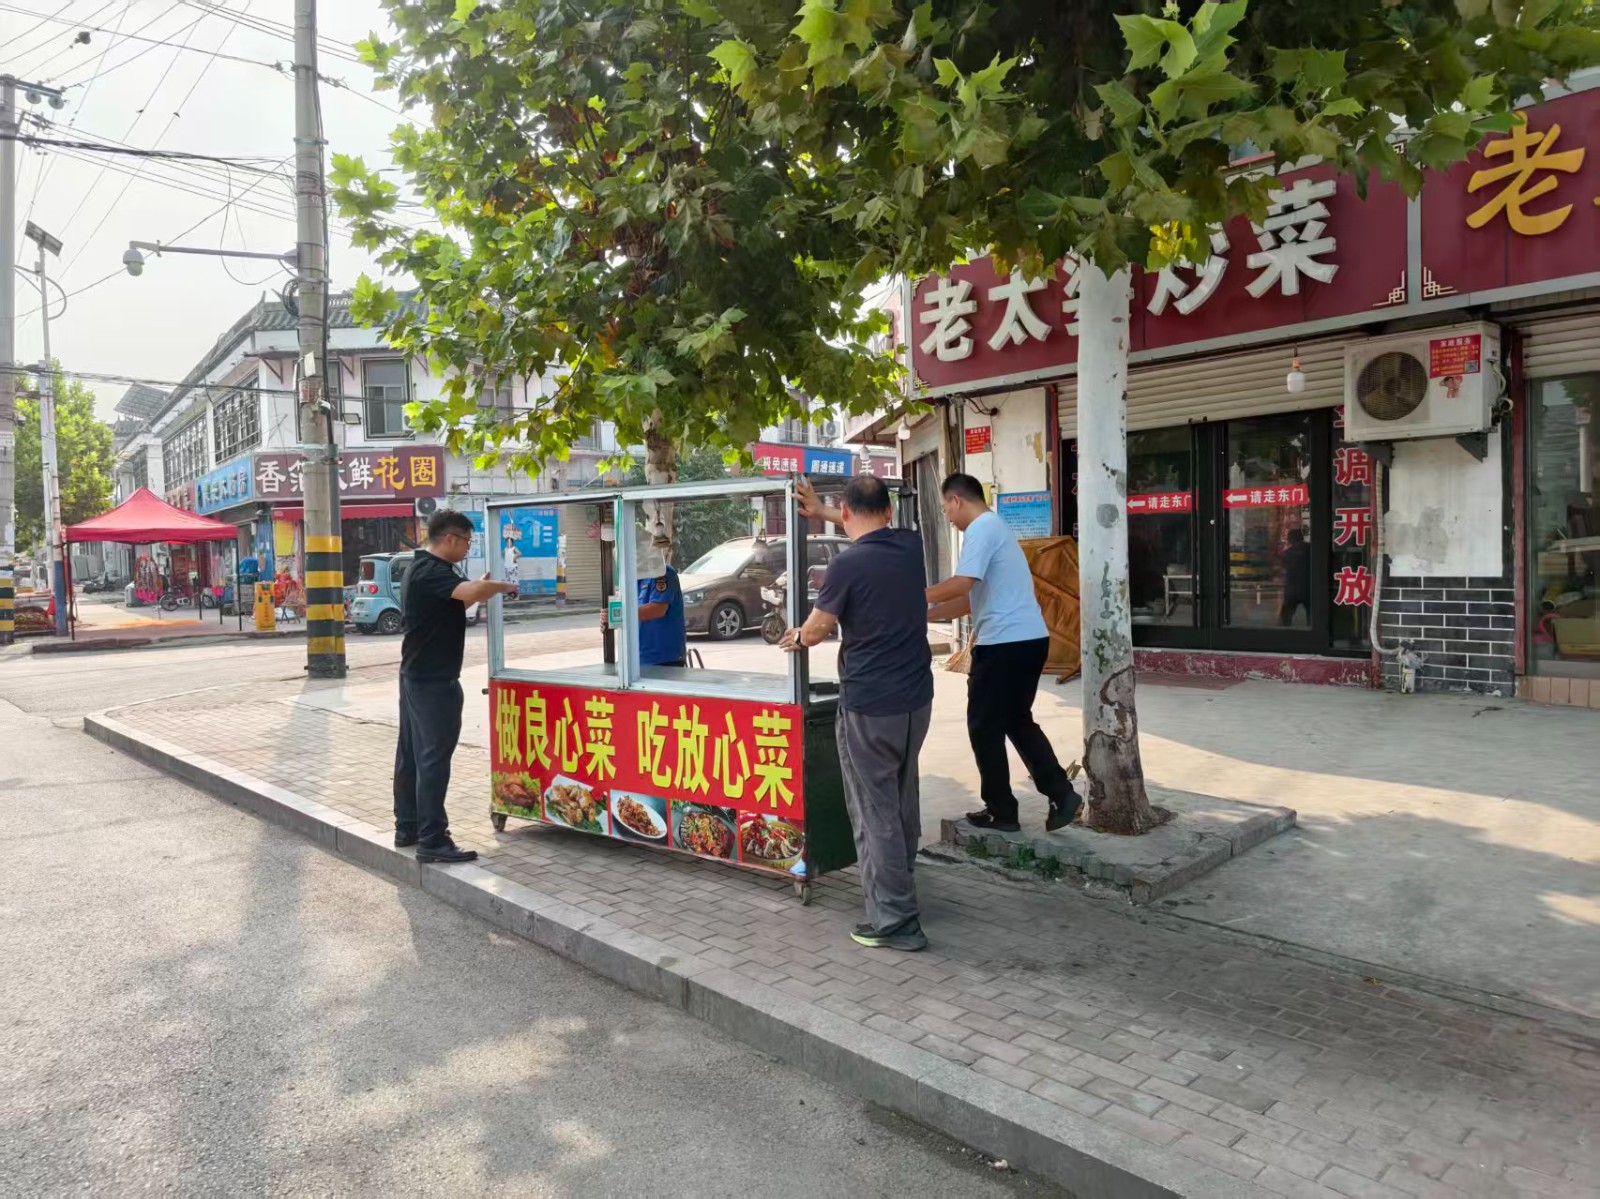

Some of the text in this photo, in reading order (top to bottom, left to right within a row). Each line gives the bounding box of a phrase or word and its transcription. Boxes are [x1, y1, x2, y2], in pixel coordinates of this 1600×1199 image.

[919, 178, 1339, 361] 老太炒菜
[1250, 488, 1304, 504] 请走东门
[1333, 405, 1374, 606] 调开放
[496, 688, 794, 808] 做良心菜 吃放心菜
